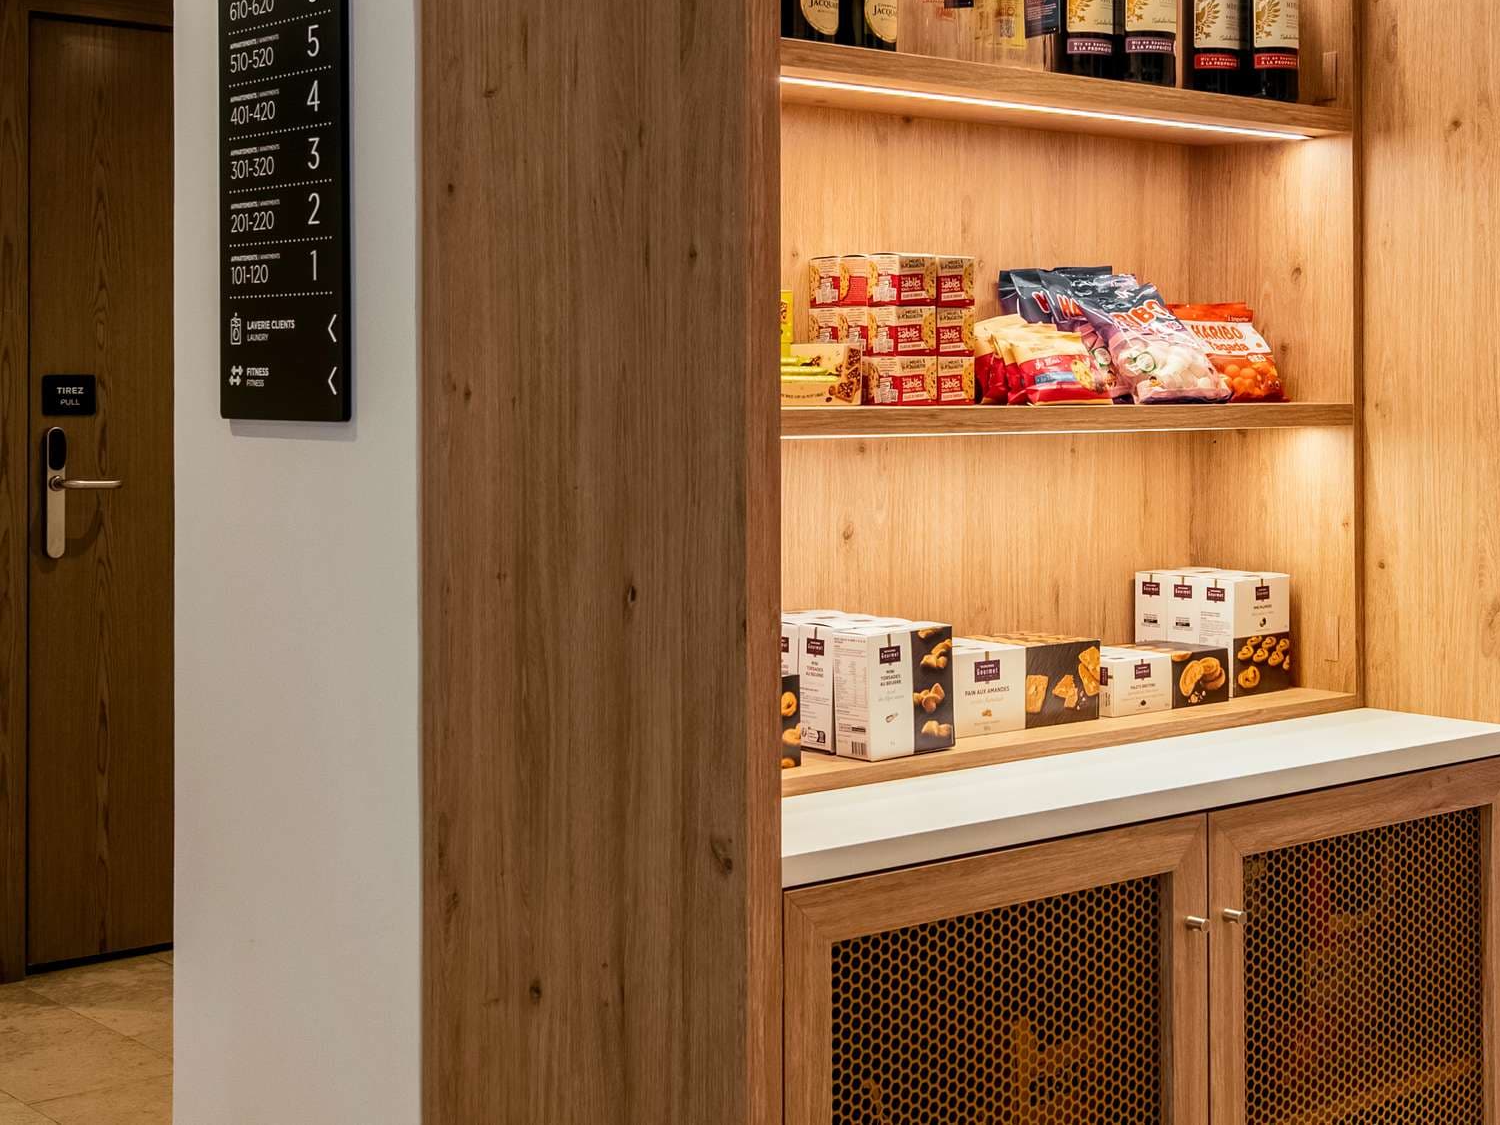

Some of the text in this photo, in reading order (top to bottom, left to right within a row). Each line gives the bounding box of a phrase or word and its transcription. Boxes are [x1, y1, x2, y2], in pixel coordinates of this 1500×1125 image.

[307, 24, 319, 57] 5
[230, 46, 274, 73] 510-520
[306, 79, 320, 112] 4
[230, 100, 275, 125] 401-420
[307, 137, 320, 170] 3
[230, 156, 275, 180] 301-320
[307, 192, 320, 225] 2
[230, 210, 275, 233] 201-220
[231, 264, 269, 285] 101-120
[310, 249, 318, 281] 1
[247, 319, 295, 330] LAVERIE CLIENTS
[1191, 324, 1244, 340] HARIBO
[1205, 340, 1249, 354] Tagada
[246, 367, 269, 376] FITNESS
[56, 386, 84, 395] TIREZ
[60, 398, 80, 406] PULL
